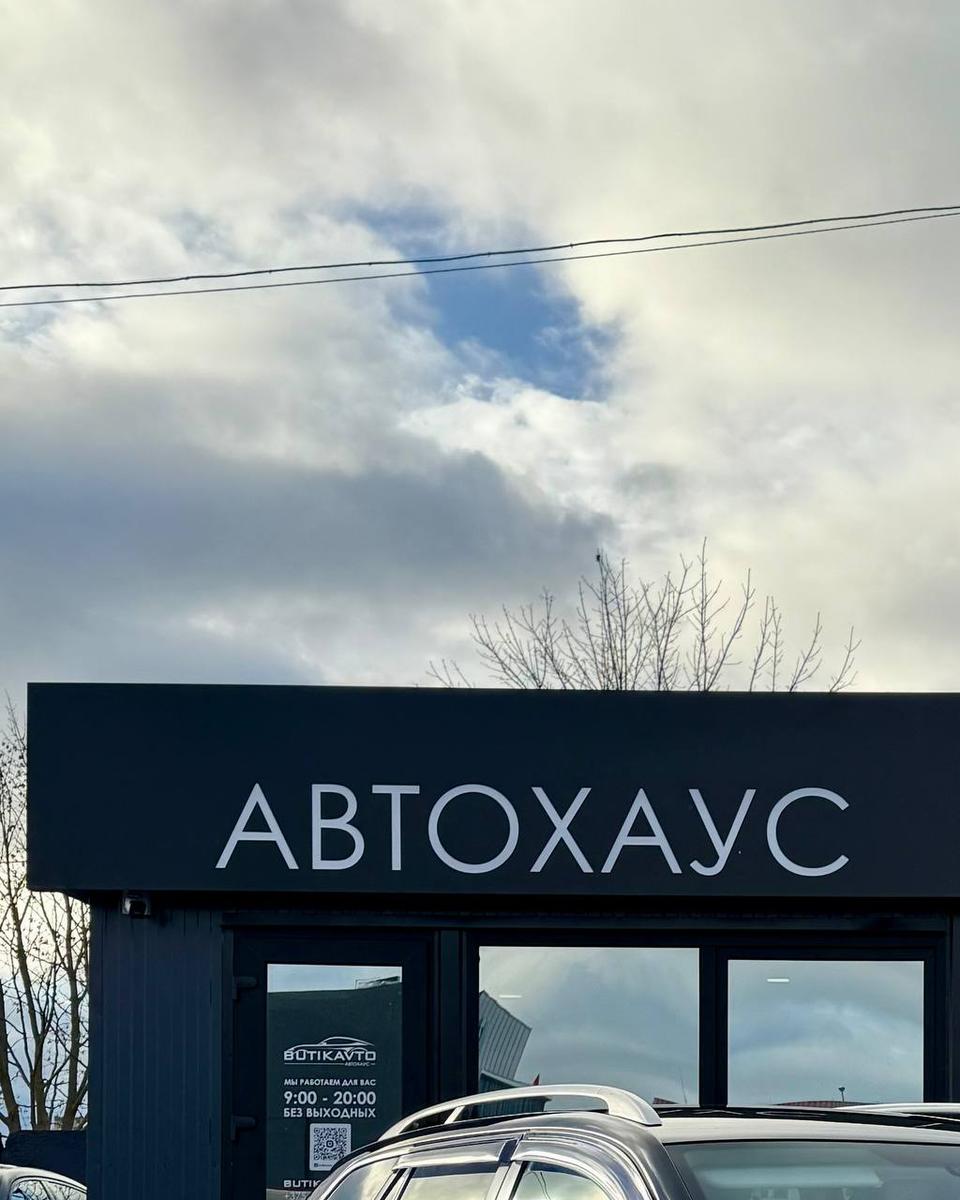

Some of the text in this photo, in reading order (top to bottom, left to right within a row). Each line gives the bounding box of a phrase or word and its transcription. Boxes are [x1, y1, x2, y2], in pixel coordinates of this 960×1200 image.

[215, 782, 850, 877] АВТОХАУС
[284, 1050, 376, 1061] BUTIKAVTO
[283, 1078, 376, 1087] МЫ РАБОТАЕМ ДЛЯ ВАС
[284, 1091, 317, 1105] 9:00
[333, 1091, 376, 1105] 20:00
[283, 1107, 376, 1119] БЕЗ ВЫХОДНЫХ
[283, 1179, 321, 1188] BUTIK
